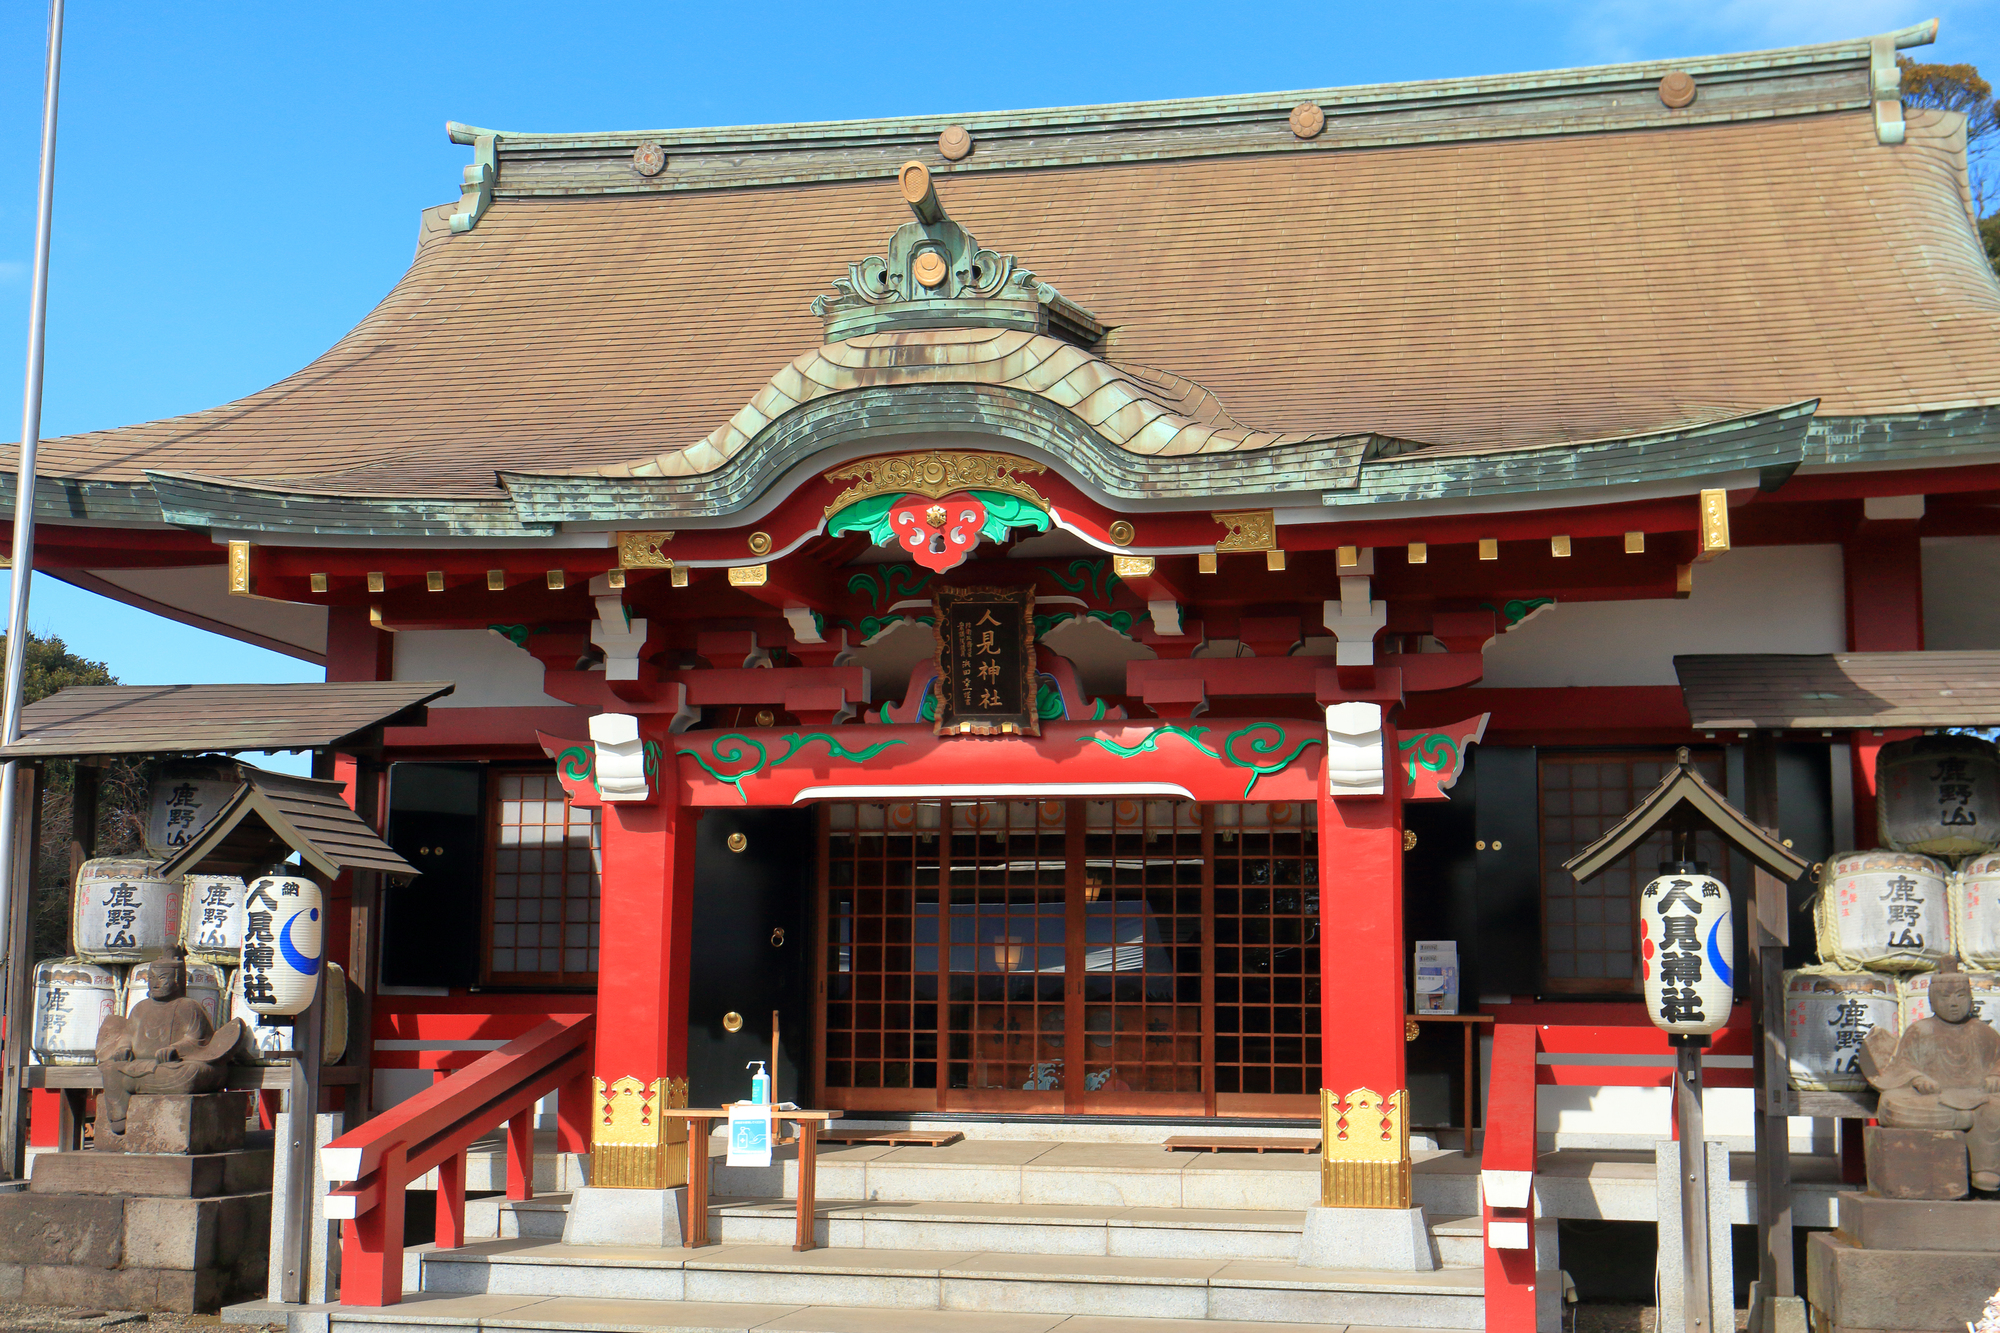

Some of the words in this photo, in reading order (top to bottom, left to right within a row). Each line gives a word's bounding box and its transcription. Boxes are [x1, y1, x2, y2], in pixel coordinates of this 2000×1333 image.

[976, 609, 1002, 709] 人見神社
[166, 782, 203, 846] 鹿野山
[1929, 757, 1975, 826] 鹿野山
[102, 882, 142, 948] 鹿野山
[199, 883, 235, 947] 鹿野山
[281, 882, 300, 897] 納
[1702, 881, 1721, 898] 納
[1879, 875, 1925, 948] 鹿野山
[243, 879, 278, 1005] 人見神社
[1657, 879, 1705, 1023] 人見神社
[40, 988, 73, 1050] 鹿野山
[1828, 998, 1874, 1074] 鹿野山
